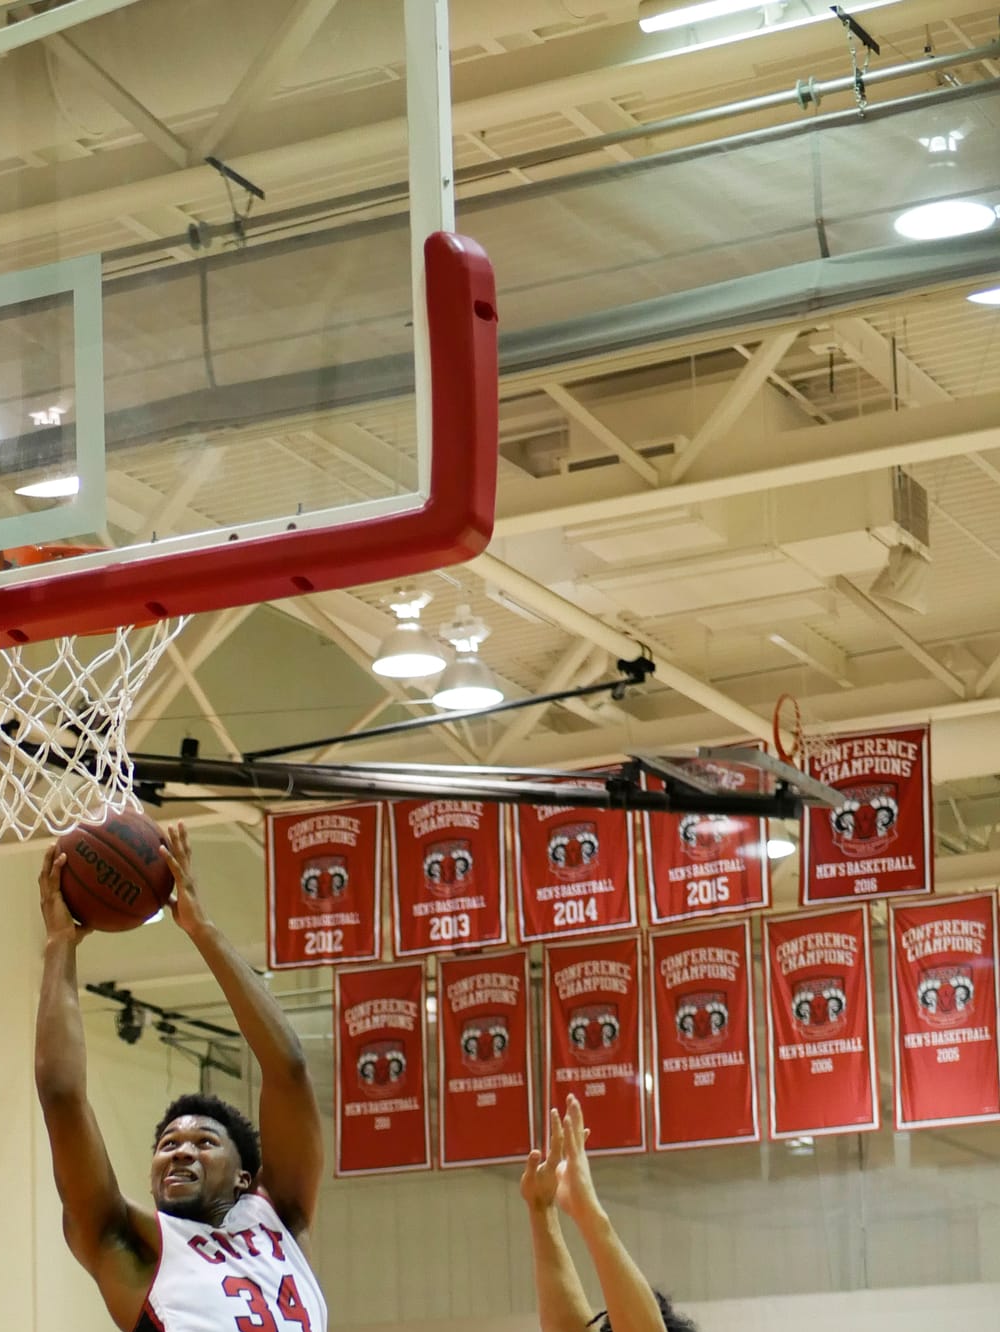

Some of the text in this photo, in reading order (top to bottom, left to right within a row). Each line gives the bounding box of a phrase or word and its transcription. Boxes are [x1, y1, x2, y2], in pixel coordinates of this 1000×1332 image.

[814, 738, 918, 771] CONFERENCE
[820, 756, 912, 785] CHAMPIONS
[409, 800, 484, 826] CONFERENCE
[413, 814, 480, 838] CHAMPIONS
[288, 815, 361, 841] CONFERENCE
[292, 829, 357, 853] CHAMPIONS
[75, 839, 141, 907] Wilson
[668, 858, 745, 882] MEN'S BASKETBALL
[816, 855, 916, 879] MEN'S BASKETBALL
[536, 878, 615, 900] MEN'S BASKETBALL
[686, 876, 729, 906] 2015
[553, 898, 597, 926] 2014
[429, 914, 470, 941] 2013
[902, 919, 986, 948] CONFERENCE
[304, 930, 343, 954] 2012
[776, 932, 858, 960] CONFERENCE
[907, 936, 982, 962] CHAMPIONS
[554, 960, 631, 986] CONFERENCE
[660, 947, 740, 974] CONFERENCE
[782, 949, 854, 975] CHAMPIONS
[447, 972, 520, 998] CONFERENCE
[559, 975, 627, 1000] CHAMPIONS
[666, 963, 736, 989] CHAMPIONS
[344, 998, 418, 1024] CONFERENCE
[451, 989, 517, 1013] CHAMPIONS
[349, 1014, 414, 1037] CHAMPIONS
[904, 1026, 991, 1049] MEN'S BASKETBALL
[779, 1036, 864, 1060] MEN'S BASKETBALL
[663, 1051, 744, 1072] MEN'S BASKETBALL
[187, 1223, 286, 1265] CITY
